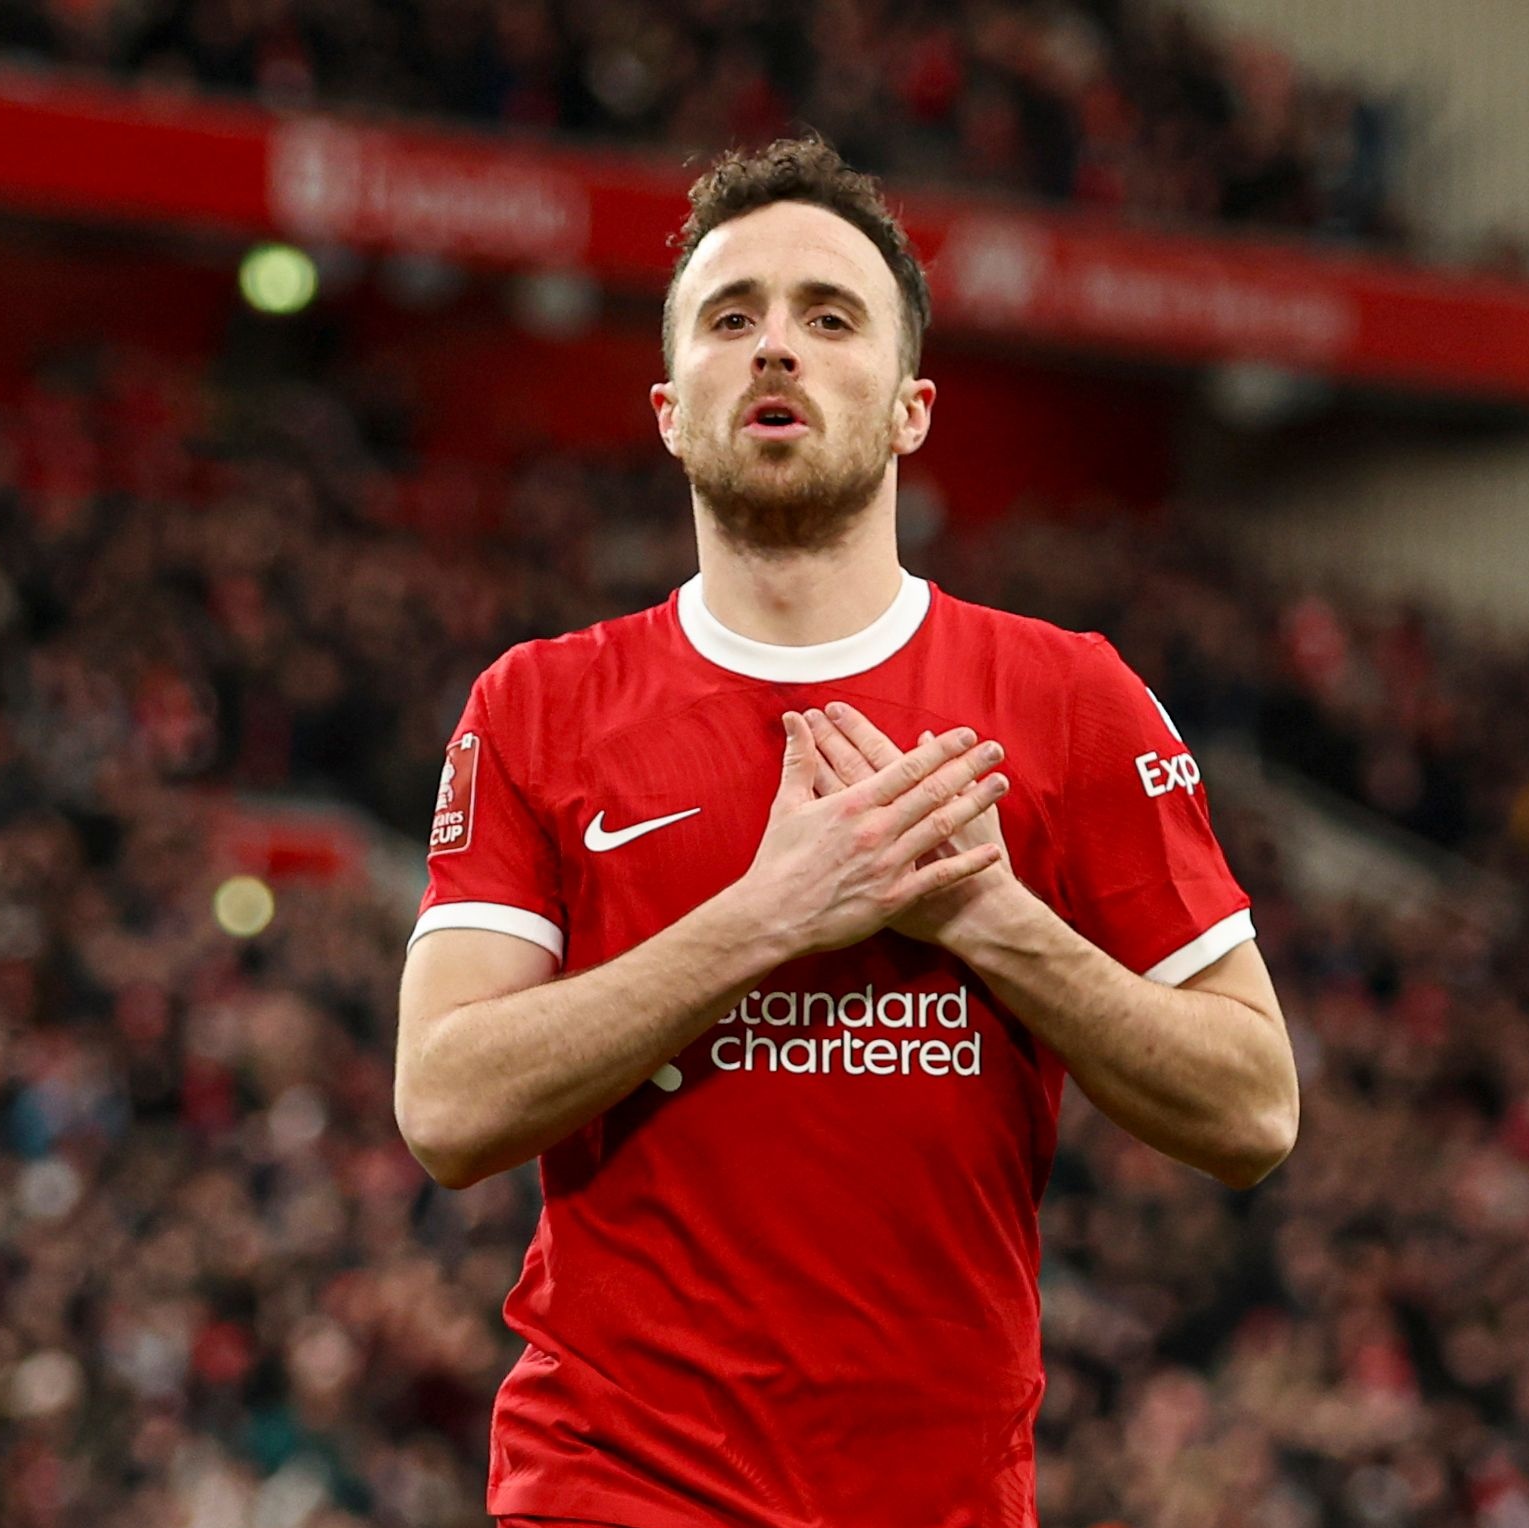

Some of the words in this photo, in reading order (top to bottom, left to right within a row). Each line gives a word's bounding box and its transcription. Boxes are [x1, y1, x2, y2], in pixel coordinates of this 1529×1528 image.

[1135, 751, 1201, 797] Exp
[429, 824, 464, 846] CUP
[711, 1028, 981, 1076] chartered
